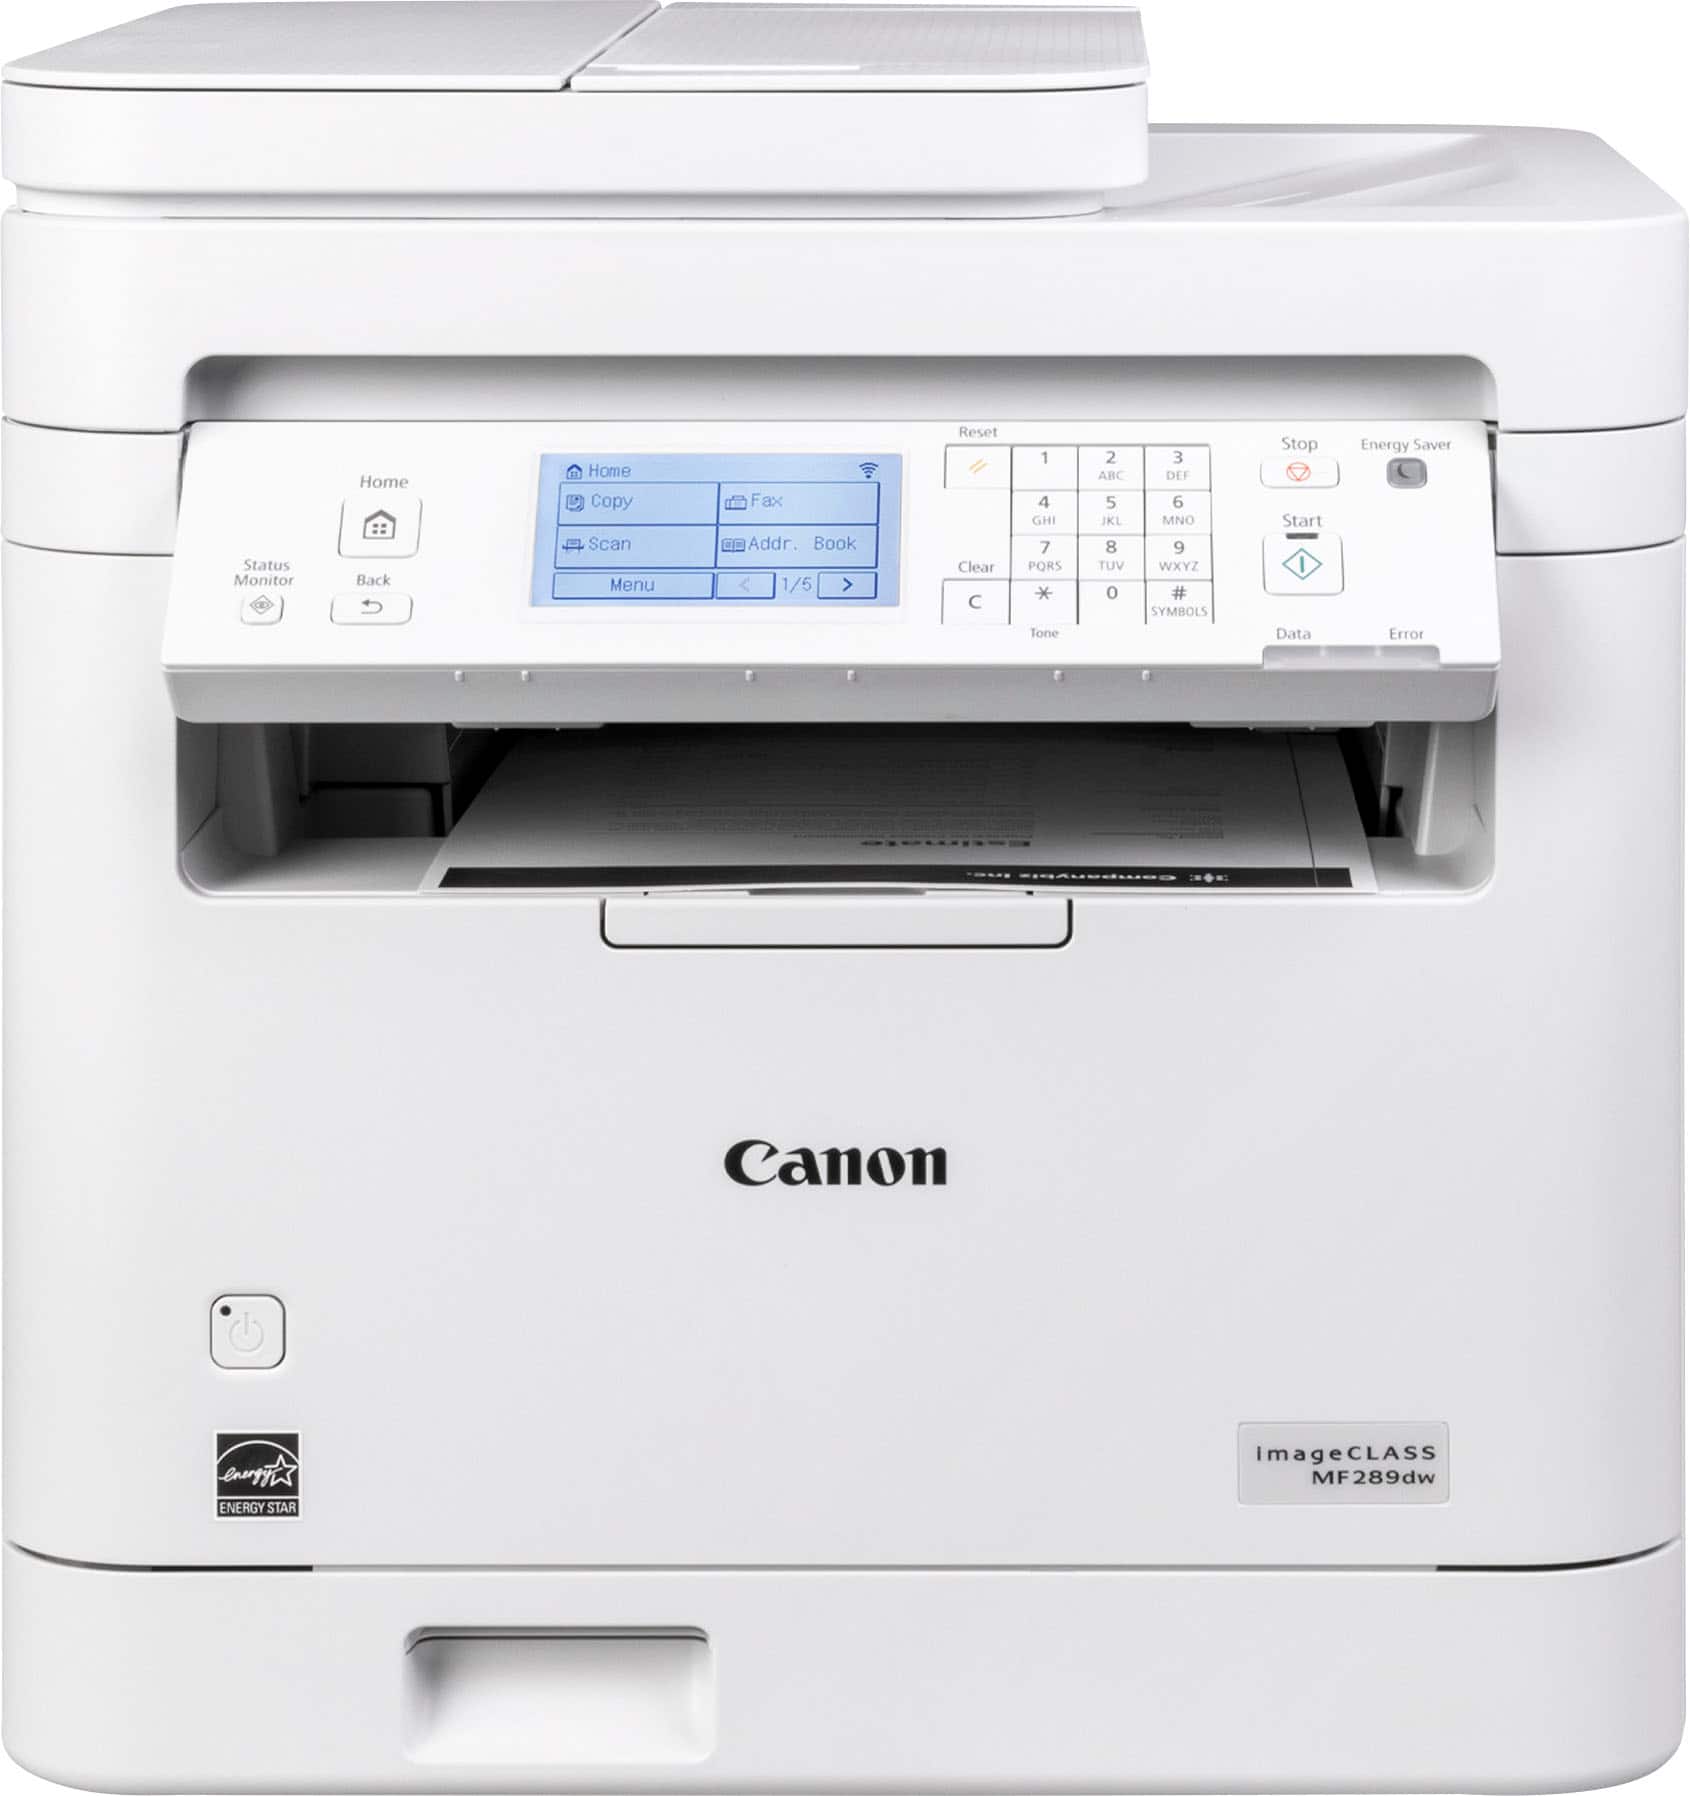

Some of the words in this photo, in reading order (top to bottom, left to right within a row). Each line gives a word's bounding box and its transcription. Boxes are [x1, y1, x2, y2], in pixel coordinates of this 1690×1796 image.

[959, 425, 998, 438] Reset
[1281, 436, 1319, 454] Stop
[1361, 438, 1410, 454] Energy
[1413, 438, 1451, 451] Saver
[1041, 450, 1048, 465] 1
[1105, 450, 1116, 465] 2
[1173, 450, 1184, 465] 3
[588, 463, 632, 479] Home
[1098, 470, 1123, 481] ABC
[1166, 470, 1189, 481] DEF
[359, 475, 409, 489] Home
[591, 493, 634, 511] Copy
[751, 492, 783, 508] Fax
[1038, 495, 1050, 509] 4
[1106, 495, 1117, 510] 5
[1172, 494, 1184, 509] 6
[1031, 515, 1056, 526] GHI
[1102, 516, 1121, 526] JKL
[1162, 515, 1195, 526] MNO
[1282, 513, 1322, 528] Start
[588, 535, 632, 552] Scan
[747, 535, 797, 551] Addr.
[813, 535, 857, 551] Book
[1039, 540, 1051, 555] 7
[1105, 539, 1118, 554] 8
[1173, 540, 1185, 555] 9
[243, 558, 291, 572] Status
[957, 560, 995, 574] Clear
[1028, 560, 1063, 573] PQRS
[1099, 559, 1125, 571] TUV
[1159, 560, 1199, 572] WXYZ
[233, 573, 294, 587] Monitor
[356, 573, 391, 586] Back
[610, 577, 655, 593] Menu
[783, 576, 812, 594] 1/5
[1106, 585, 1119, 600] 0
[968, 594, 982, 610] C
[1151, 606, 1208, 617] SYMBOLS
[1030, 627, 1060, 639] Tone
[1276, 627, 1312, 641] Data
[1389, 627, 1424, 641] Error
[723, 1139, 947, 1187] Canon
[1256, 1445, 1436, 1466] imageCLASS
[1312, 1469, 1436, 1485] MF289dw
[219, 1501, 266, 1515] ENERGY
[266, 1501, 297, 1515] STAR
